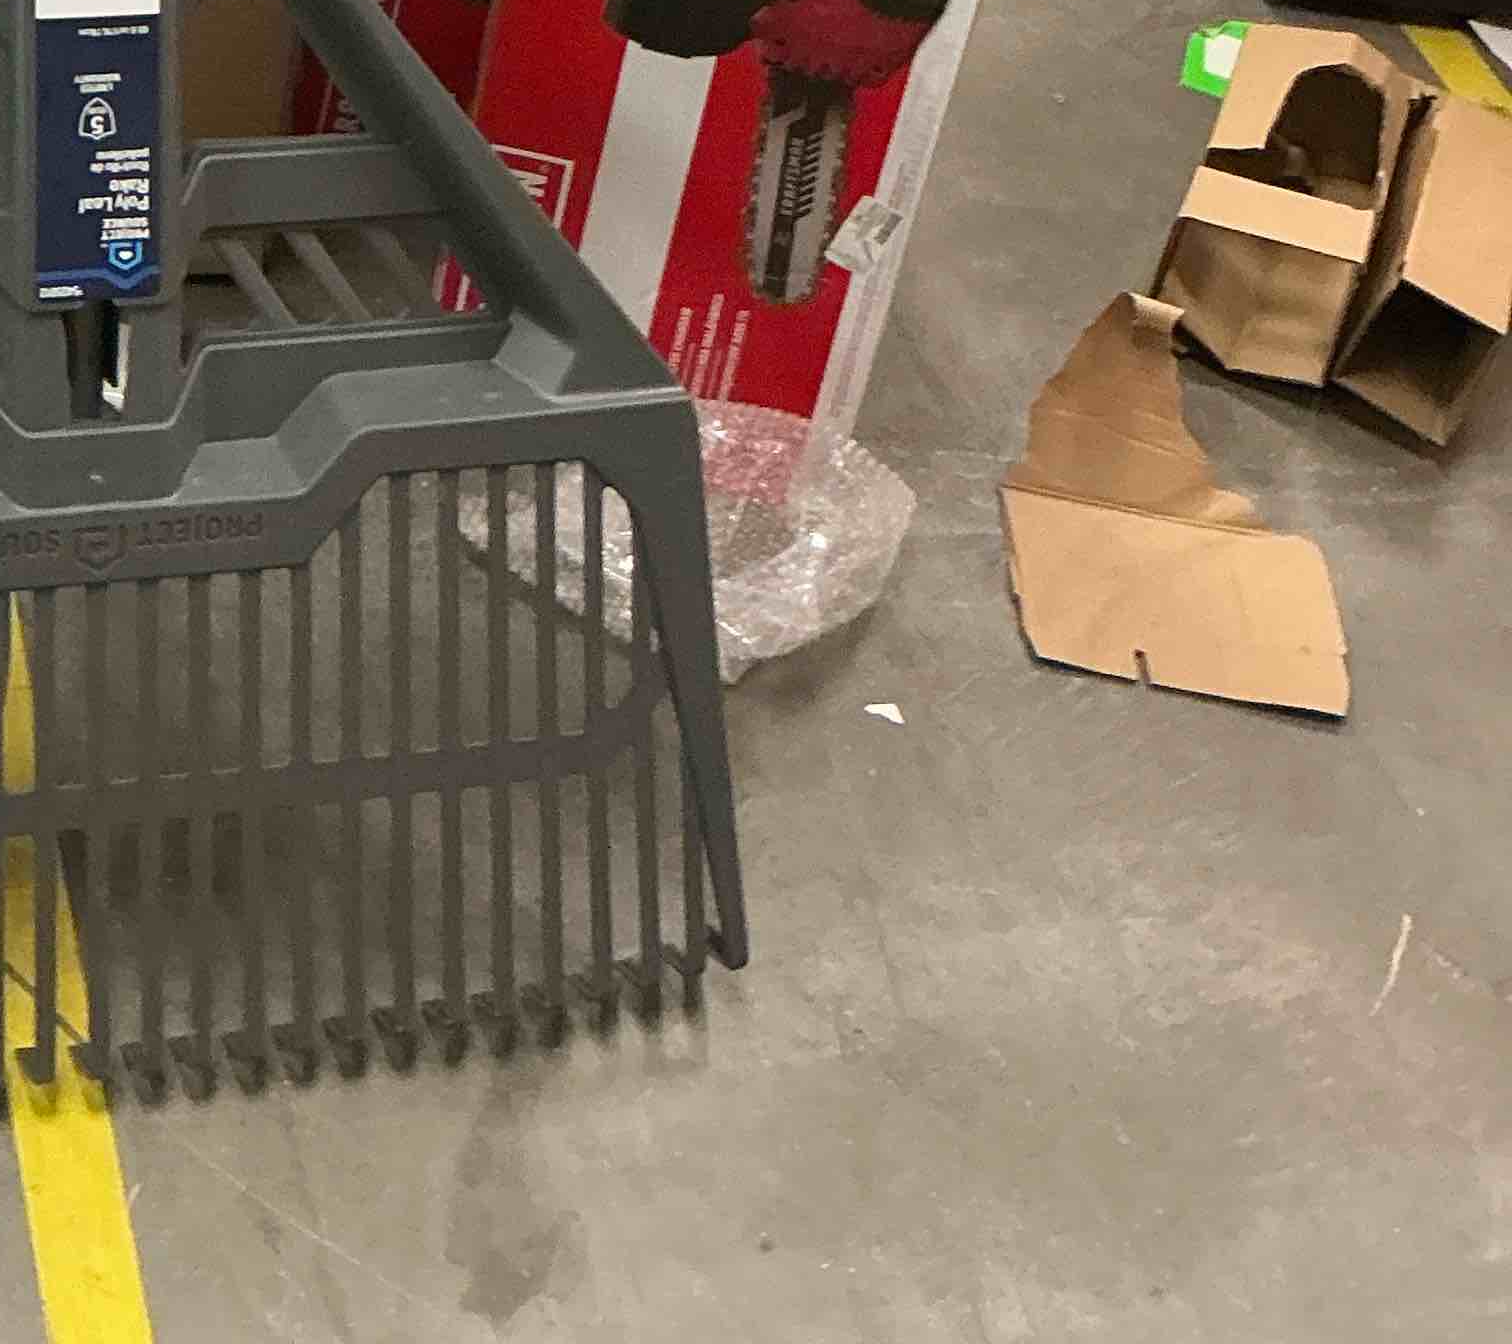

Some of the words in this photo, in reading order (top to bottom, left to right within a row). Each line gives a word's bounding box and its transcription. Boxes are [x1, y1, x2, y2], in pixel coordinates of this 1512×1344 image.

[90, 114, 104, 135] 5
[108, 177, 150, 194] Rake
[77, 195, 113, 215] Leaf
[114, 193, 150, 211] Poly
[135, 512, 264, 548] PROJECT
